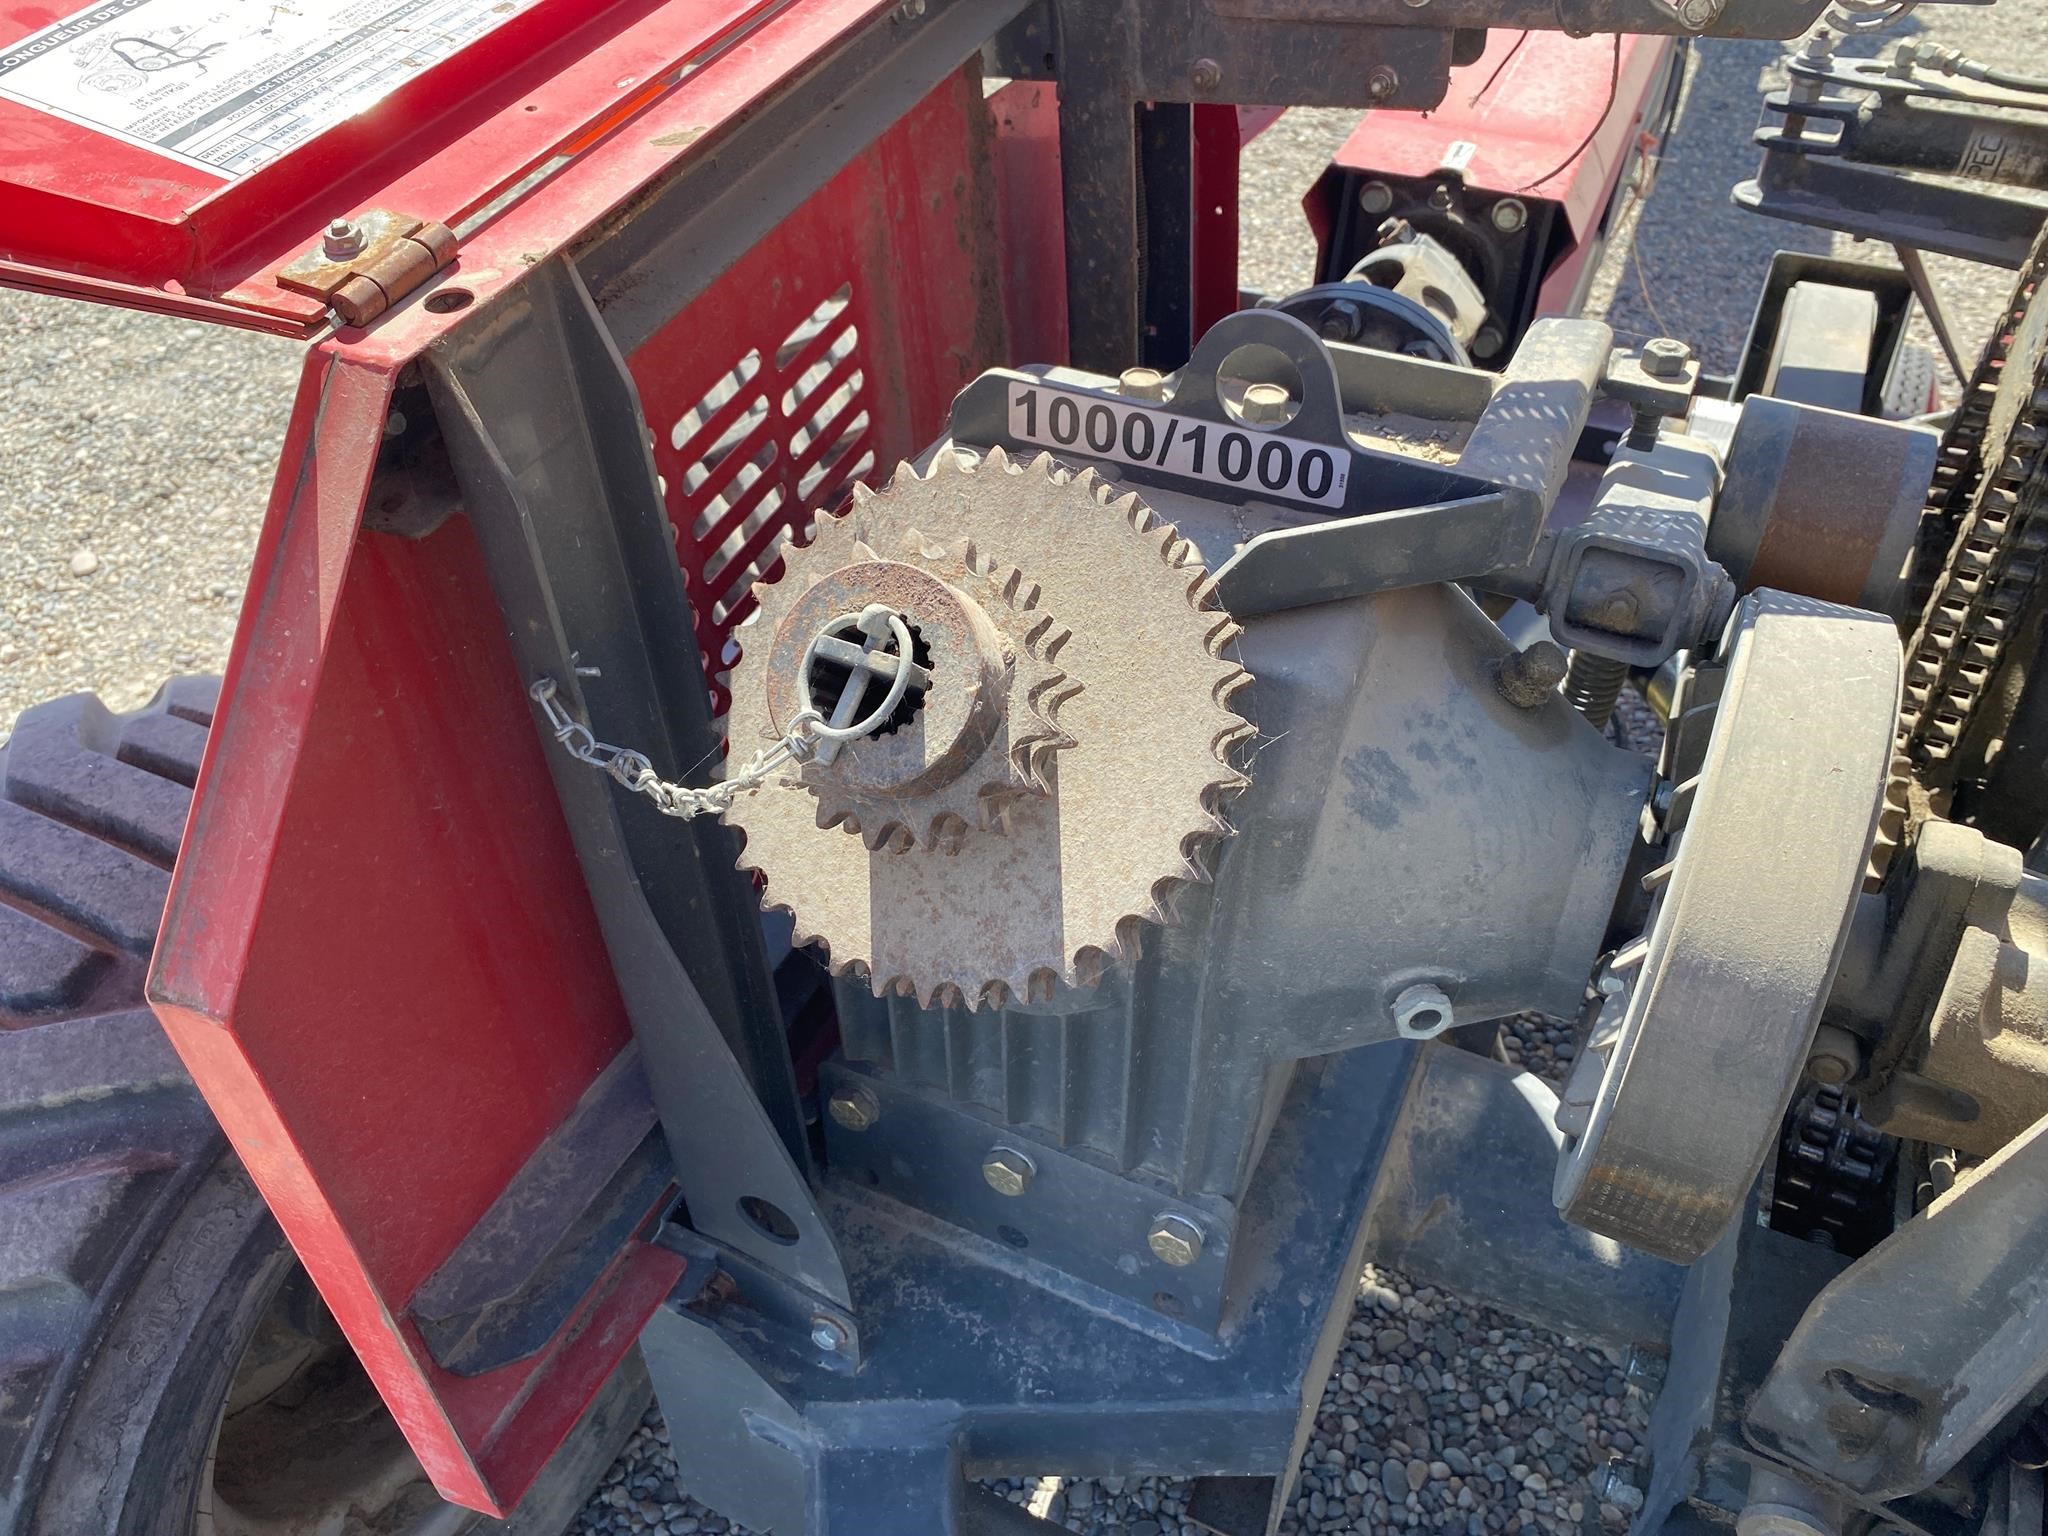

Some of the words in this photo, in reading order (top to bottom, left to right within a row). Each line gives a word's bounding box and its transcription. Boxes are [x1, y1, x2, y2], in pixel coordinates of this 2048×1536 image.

[94, 6, 123, 21] DE
[253, 82, 277, 94] LOC
[1966, 134, 2002, 178] PEC
[1015, 389, 1334, 499] 1000/1000
